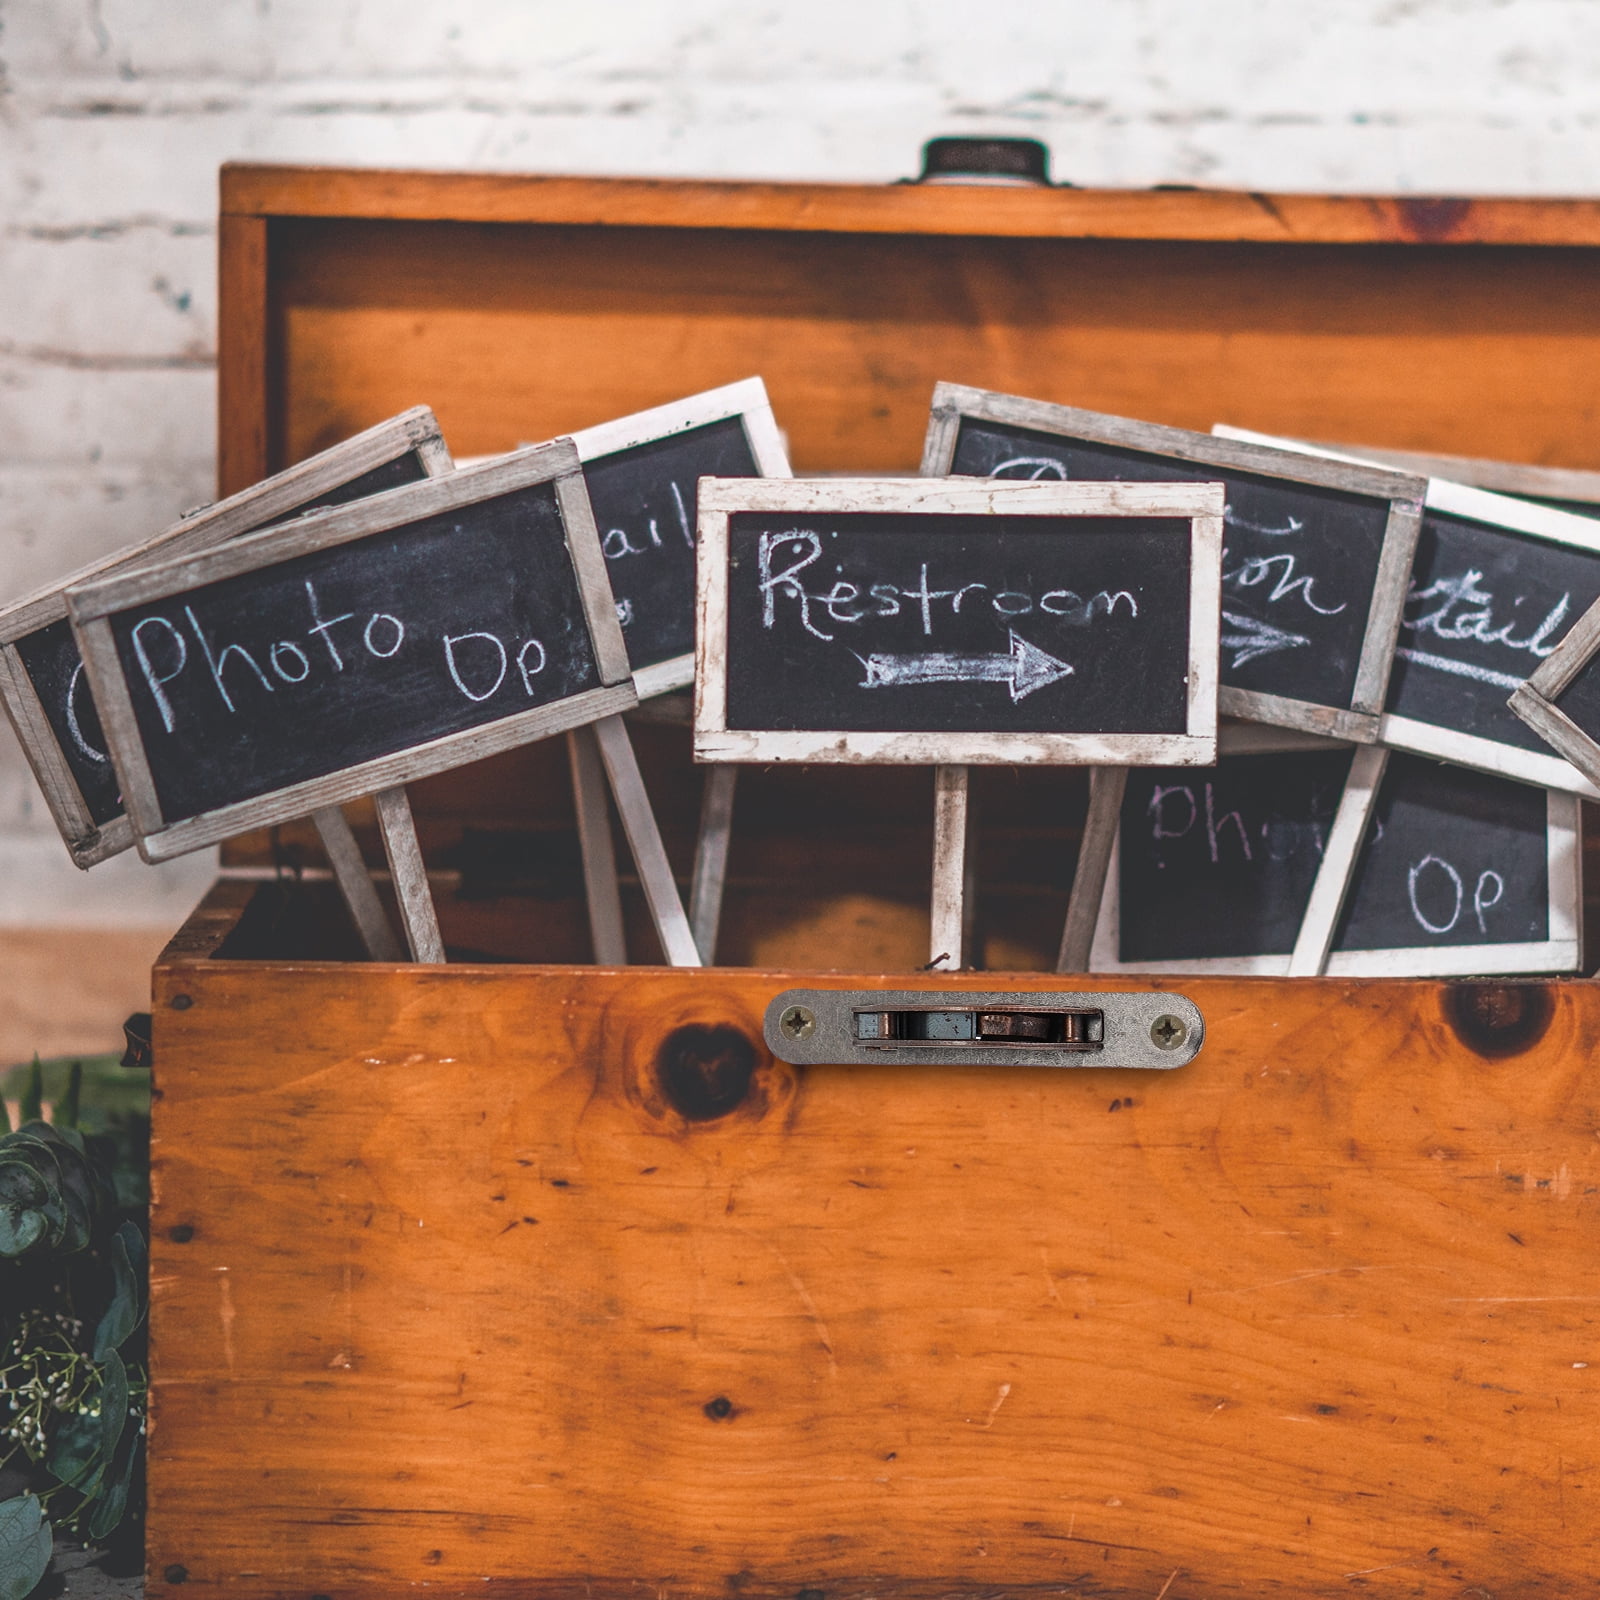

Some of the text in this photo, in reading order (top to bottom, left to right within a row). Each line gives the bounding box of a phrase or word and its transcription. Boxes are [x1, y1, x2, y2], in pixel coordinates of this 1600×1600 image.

[602, 481, 695, 560] ail
[759, 529, 1138, 641] Restroom
[1404, 568, 1569, 657] tail
[131, 581, 404, 734] Photo
[444, 632, 546, 702] Op
[1147, 781, 1384, 868] Pho
[1409, 854, 1504, 934] Op
